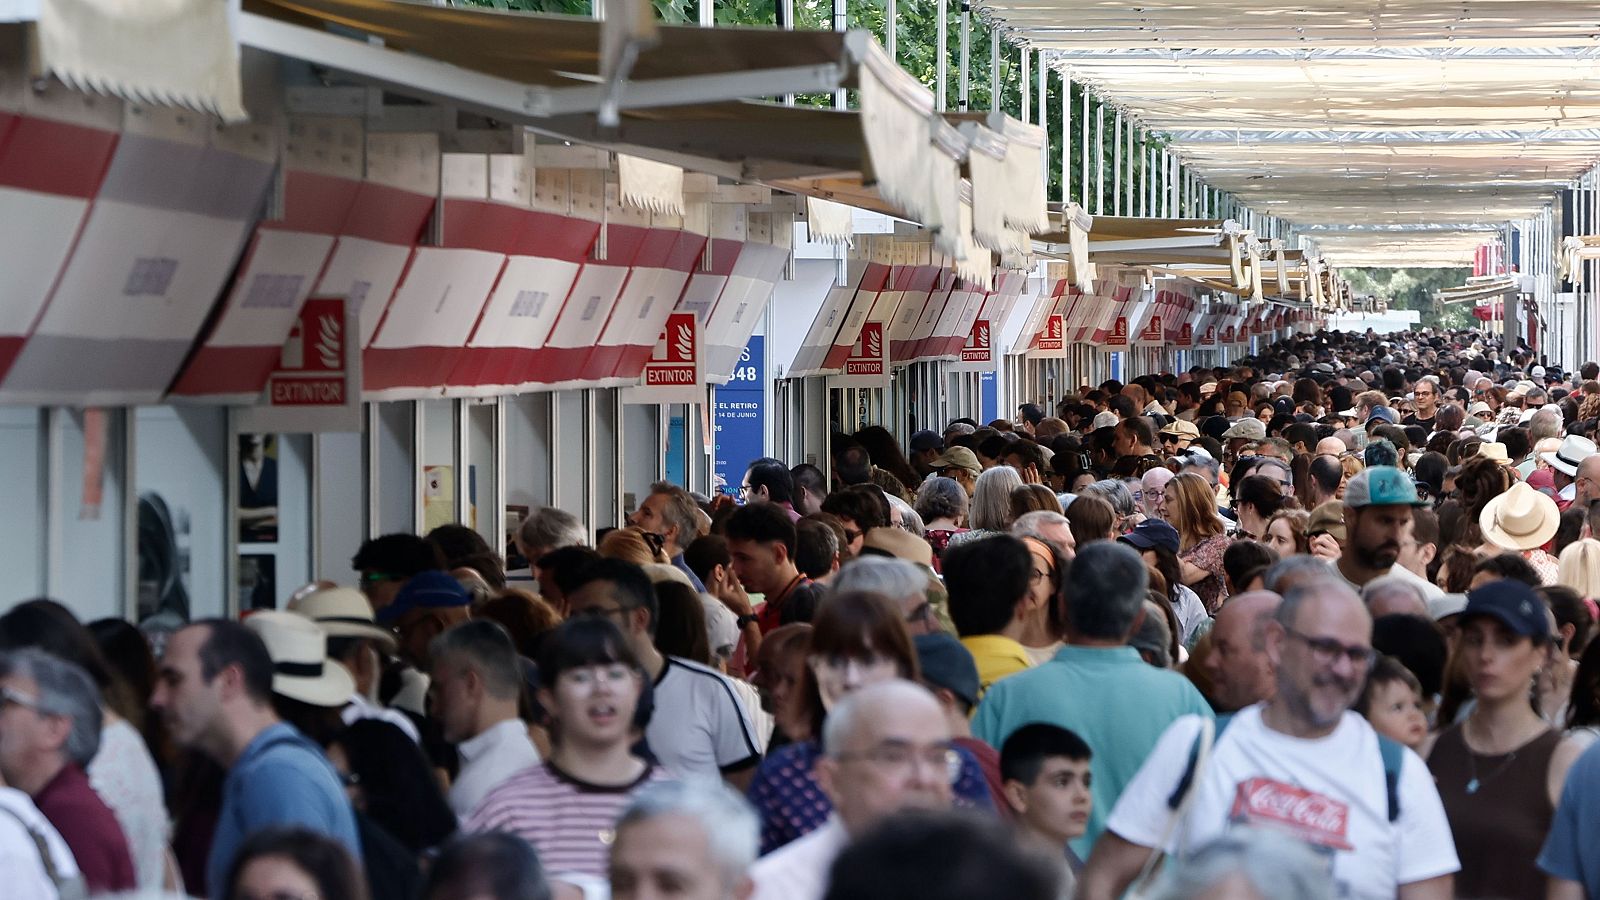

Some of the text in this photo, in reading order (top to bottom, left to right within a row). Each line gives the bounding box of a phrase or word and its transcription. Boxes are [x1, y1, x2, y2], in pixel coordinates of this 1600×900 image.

[963, 352, 989, 360] EXTINTOR
[848, 363, 881, 373] EXTINTOR
[648, 369, 693, 382] EXTINTOR
[274, 382, 341, 401] EXTINTOR
